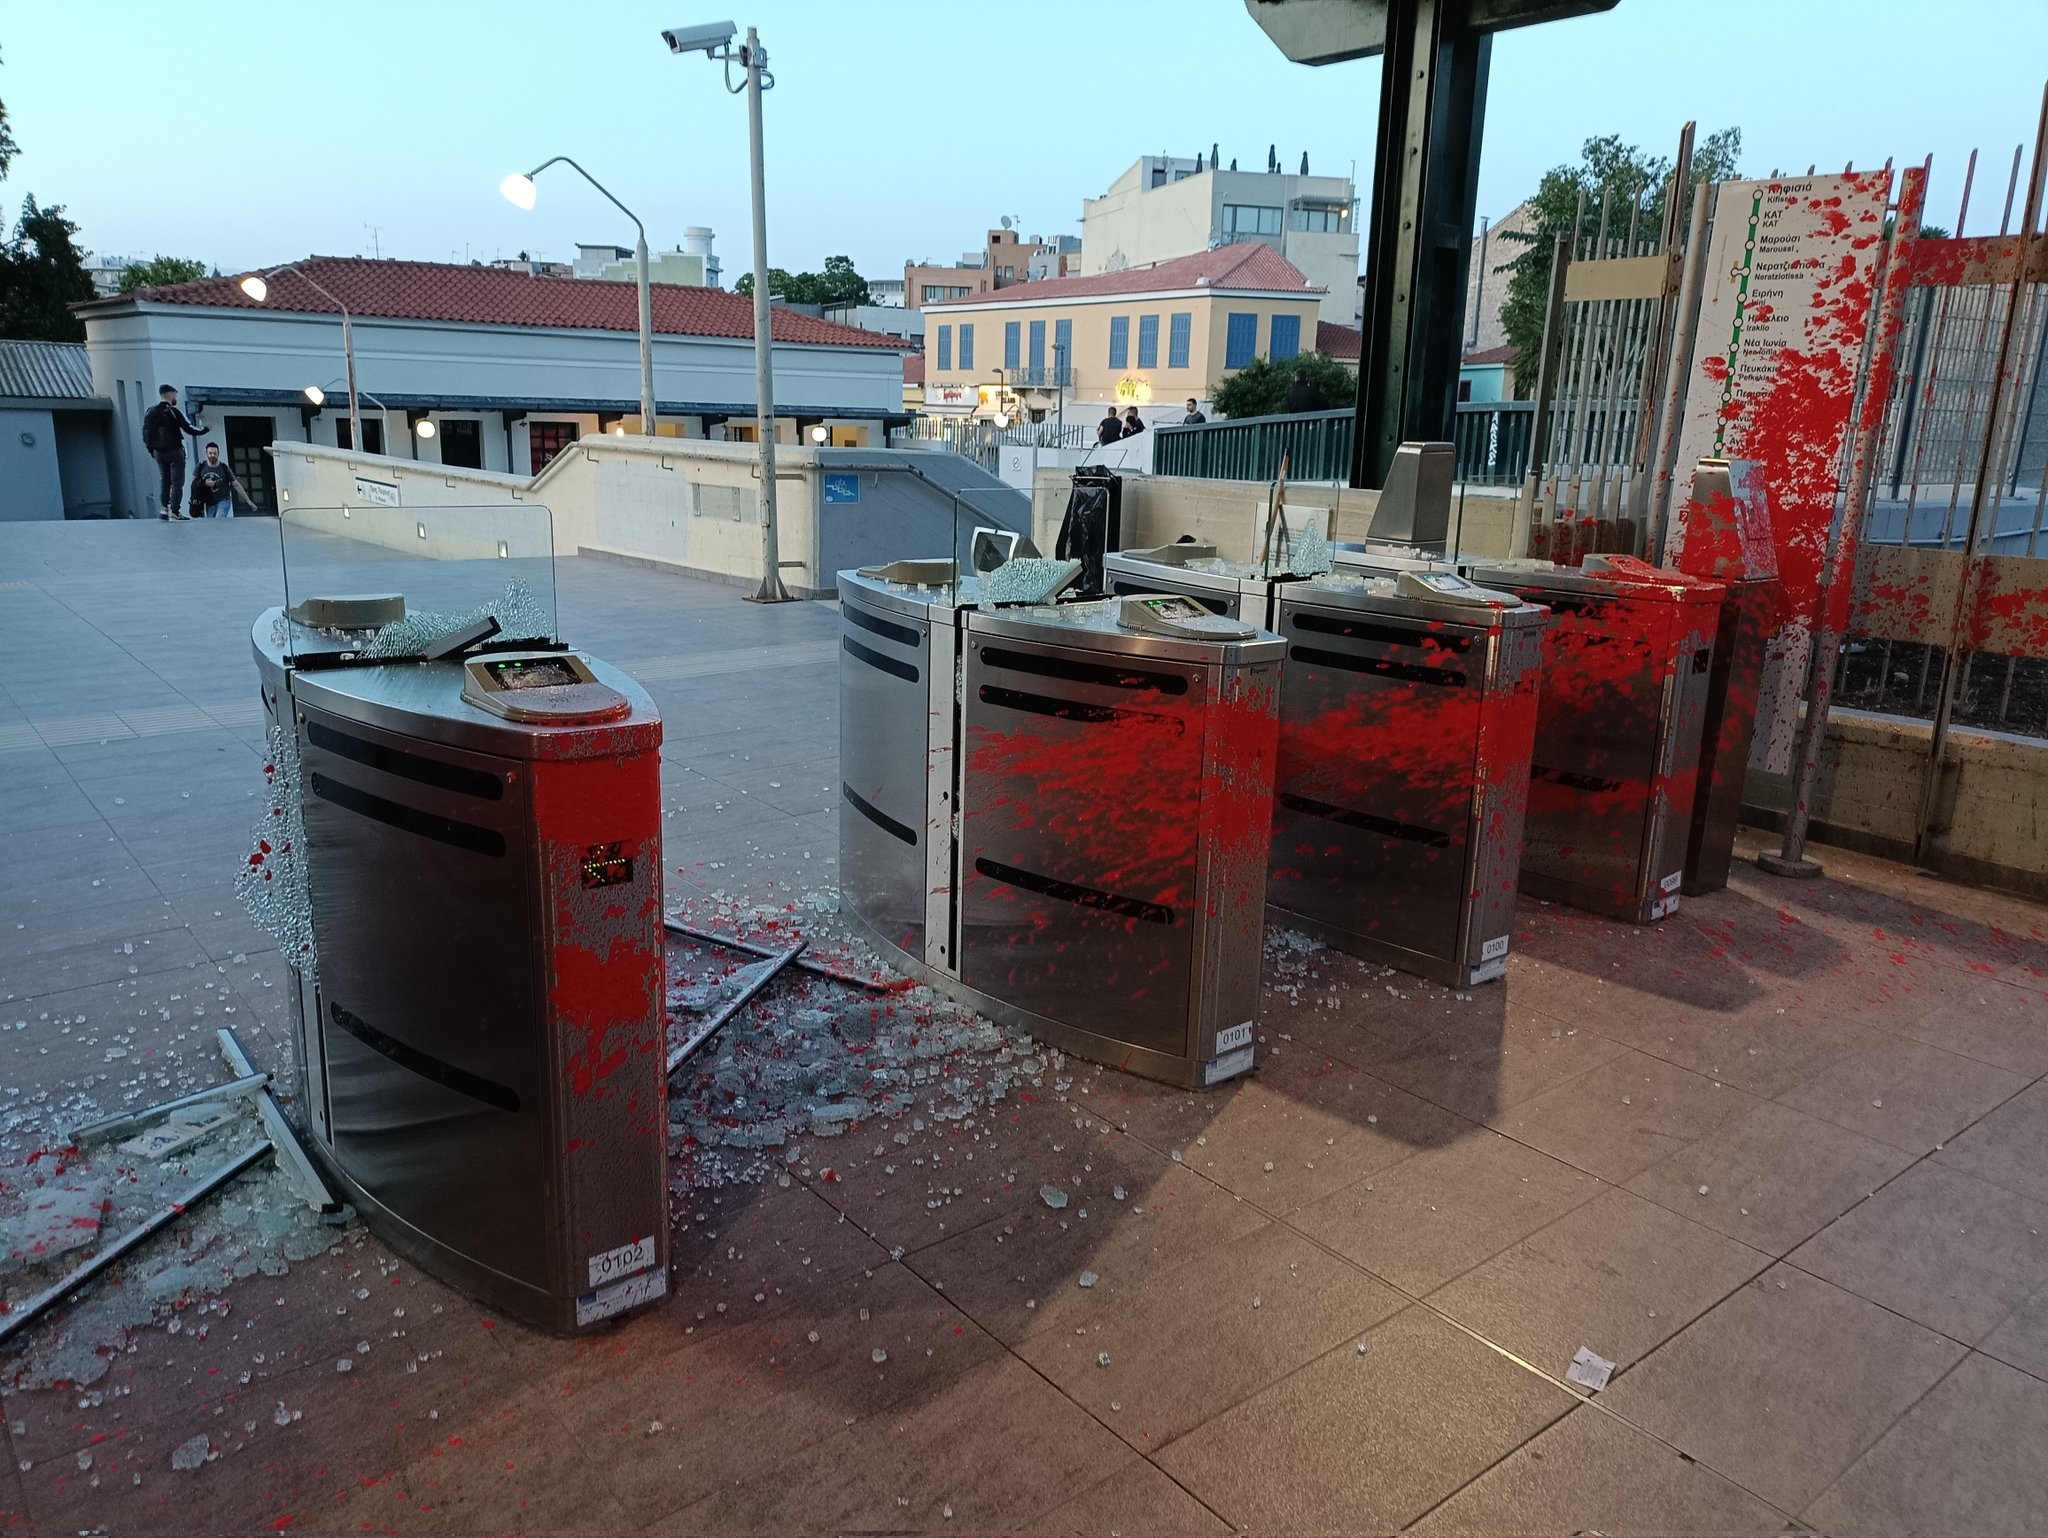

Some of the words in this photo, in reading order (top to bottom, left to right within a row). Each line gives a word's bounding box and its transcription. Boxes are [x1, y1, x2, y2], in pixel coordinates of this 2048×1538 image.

[1764, 210, 1783, 219] ΚΑΤ
[1762, 220, 1779, 228] KAT
[1760, 234, 1800, 245] Μαρούσι
[1759, 245, 1794, 253] Maroussi
[1756, 261, 1825, 272] Νερατζιτισσα
[1754, 272, 1804, 280] Neratziotissa
[1752, 289, 1784, 298] Ειρήνη
[1744, 338, 1760, 347] Νέα
[1763, 338, 1787, 347] Ιωνία
[1486, 940, 1504, 954] 0100
[1223, 1027, 1246, 1045] 0101
[601, 1246, 644, 1274] 0102
